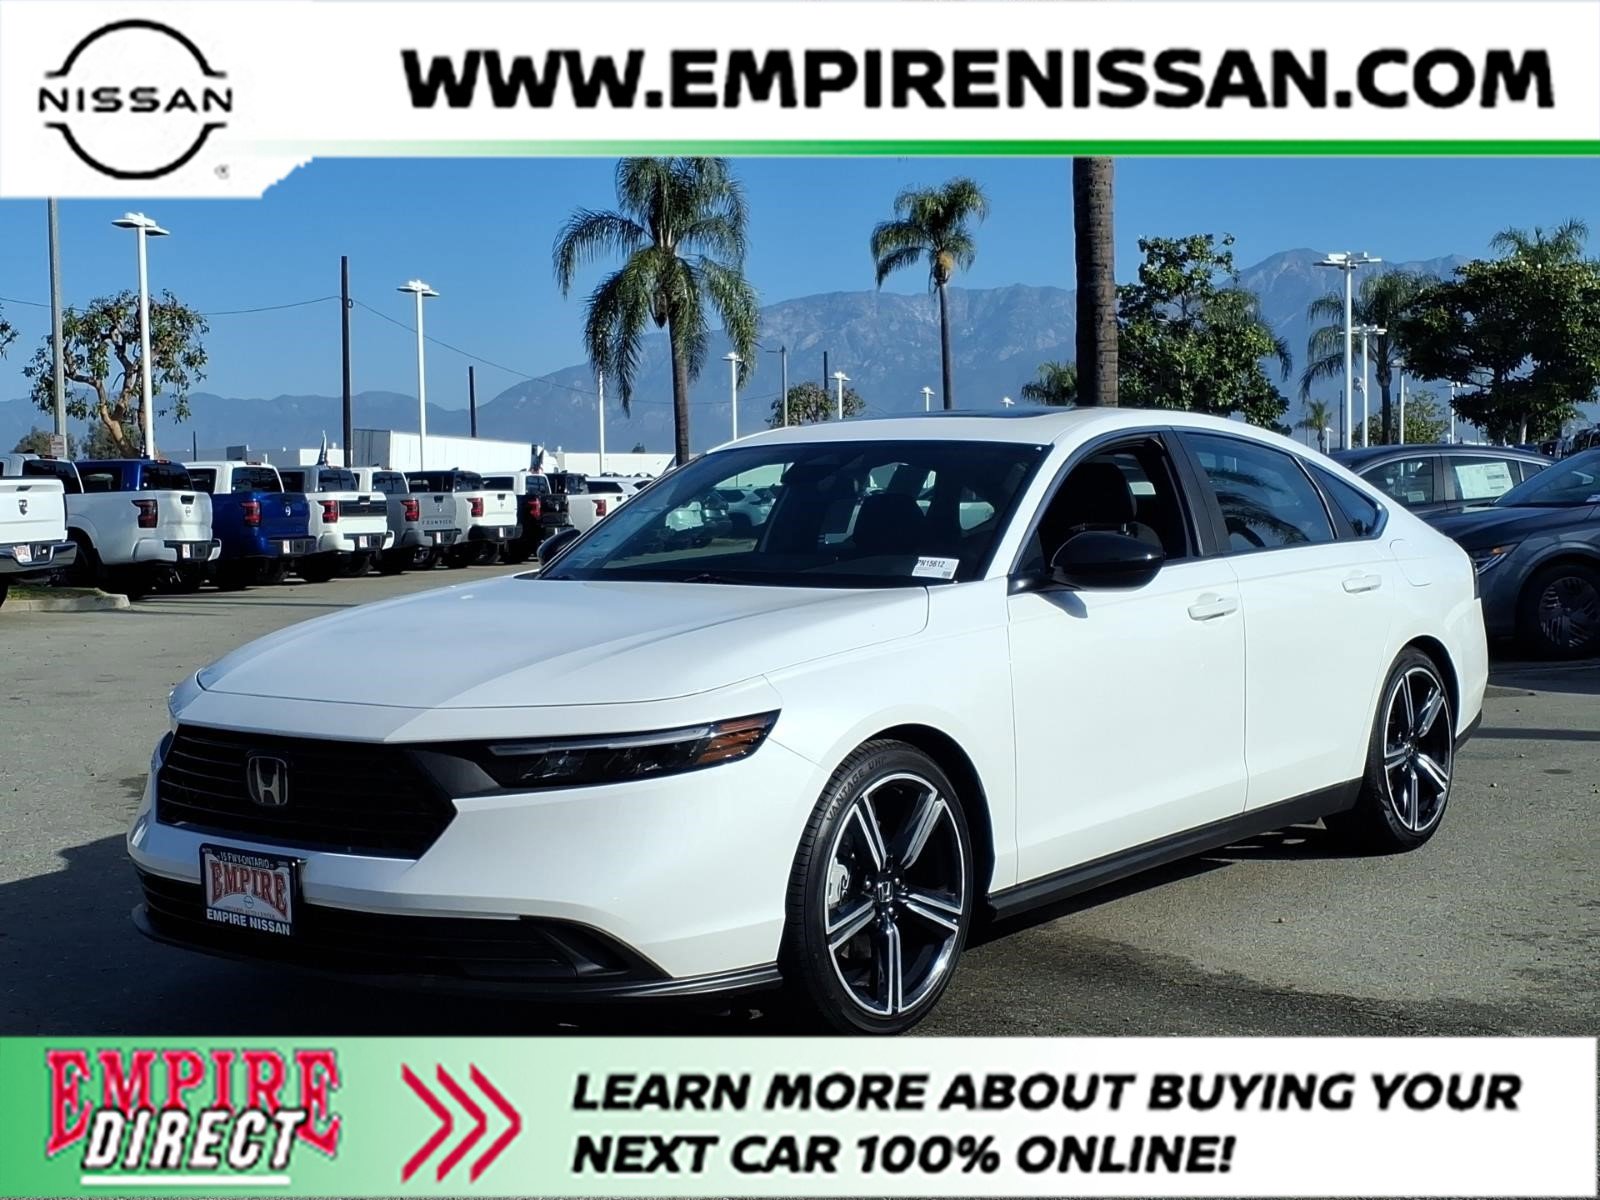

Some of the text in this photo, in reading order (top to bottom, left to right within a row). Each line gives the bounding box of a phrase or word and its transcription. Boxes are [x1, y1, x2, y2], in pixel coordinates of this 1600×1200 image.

[826, 767, 865, 821] VANTAGE
[209, 861, 288, 917] EMPIRE
[206, 908, 247, 927] EMPIRE
[249, 917, 290, 936] NISSAN
